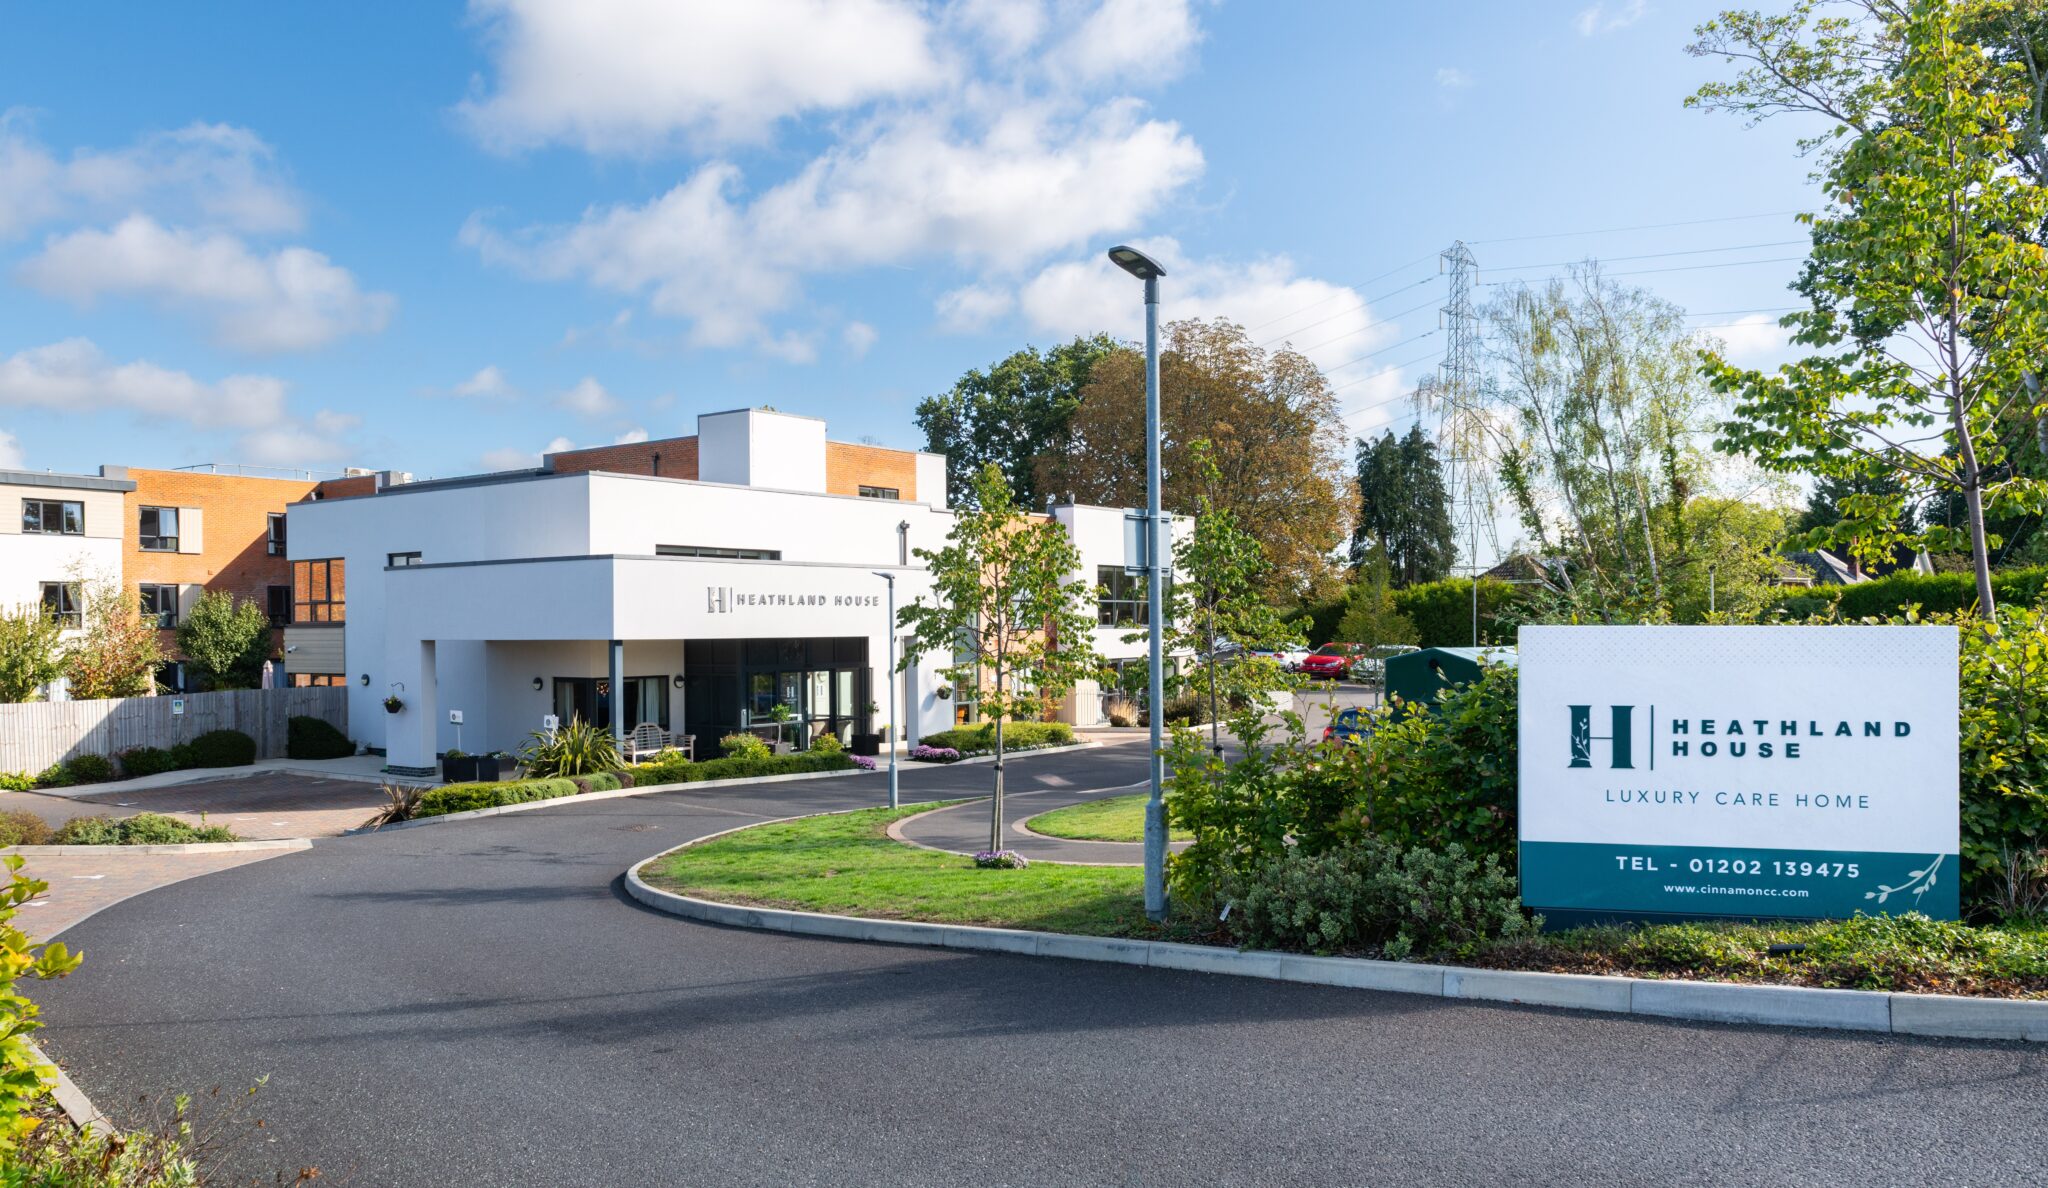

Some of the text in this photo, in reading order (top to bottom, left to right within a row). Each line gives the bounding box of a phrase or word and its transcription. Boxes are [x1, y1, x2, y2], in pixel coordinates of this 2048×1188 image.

[736, 593, 827, 607] HEATHLAND
[834, 595, 880, 607] HOUSE
[1672, 719, 1912, 738] HEATHLAND
[1672, 740, 1801, 759] HOUSE
[1606, 788, 1870, 809] LUXURY CARE HOME
[1616, 855, 1659, 872] TEL
[1689, 858, 1762, 875] 01202
[1773, 861, 1861, 878] 139475
[1663, 884, 1810, 898] www.cinnamoncc.com
